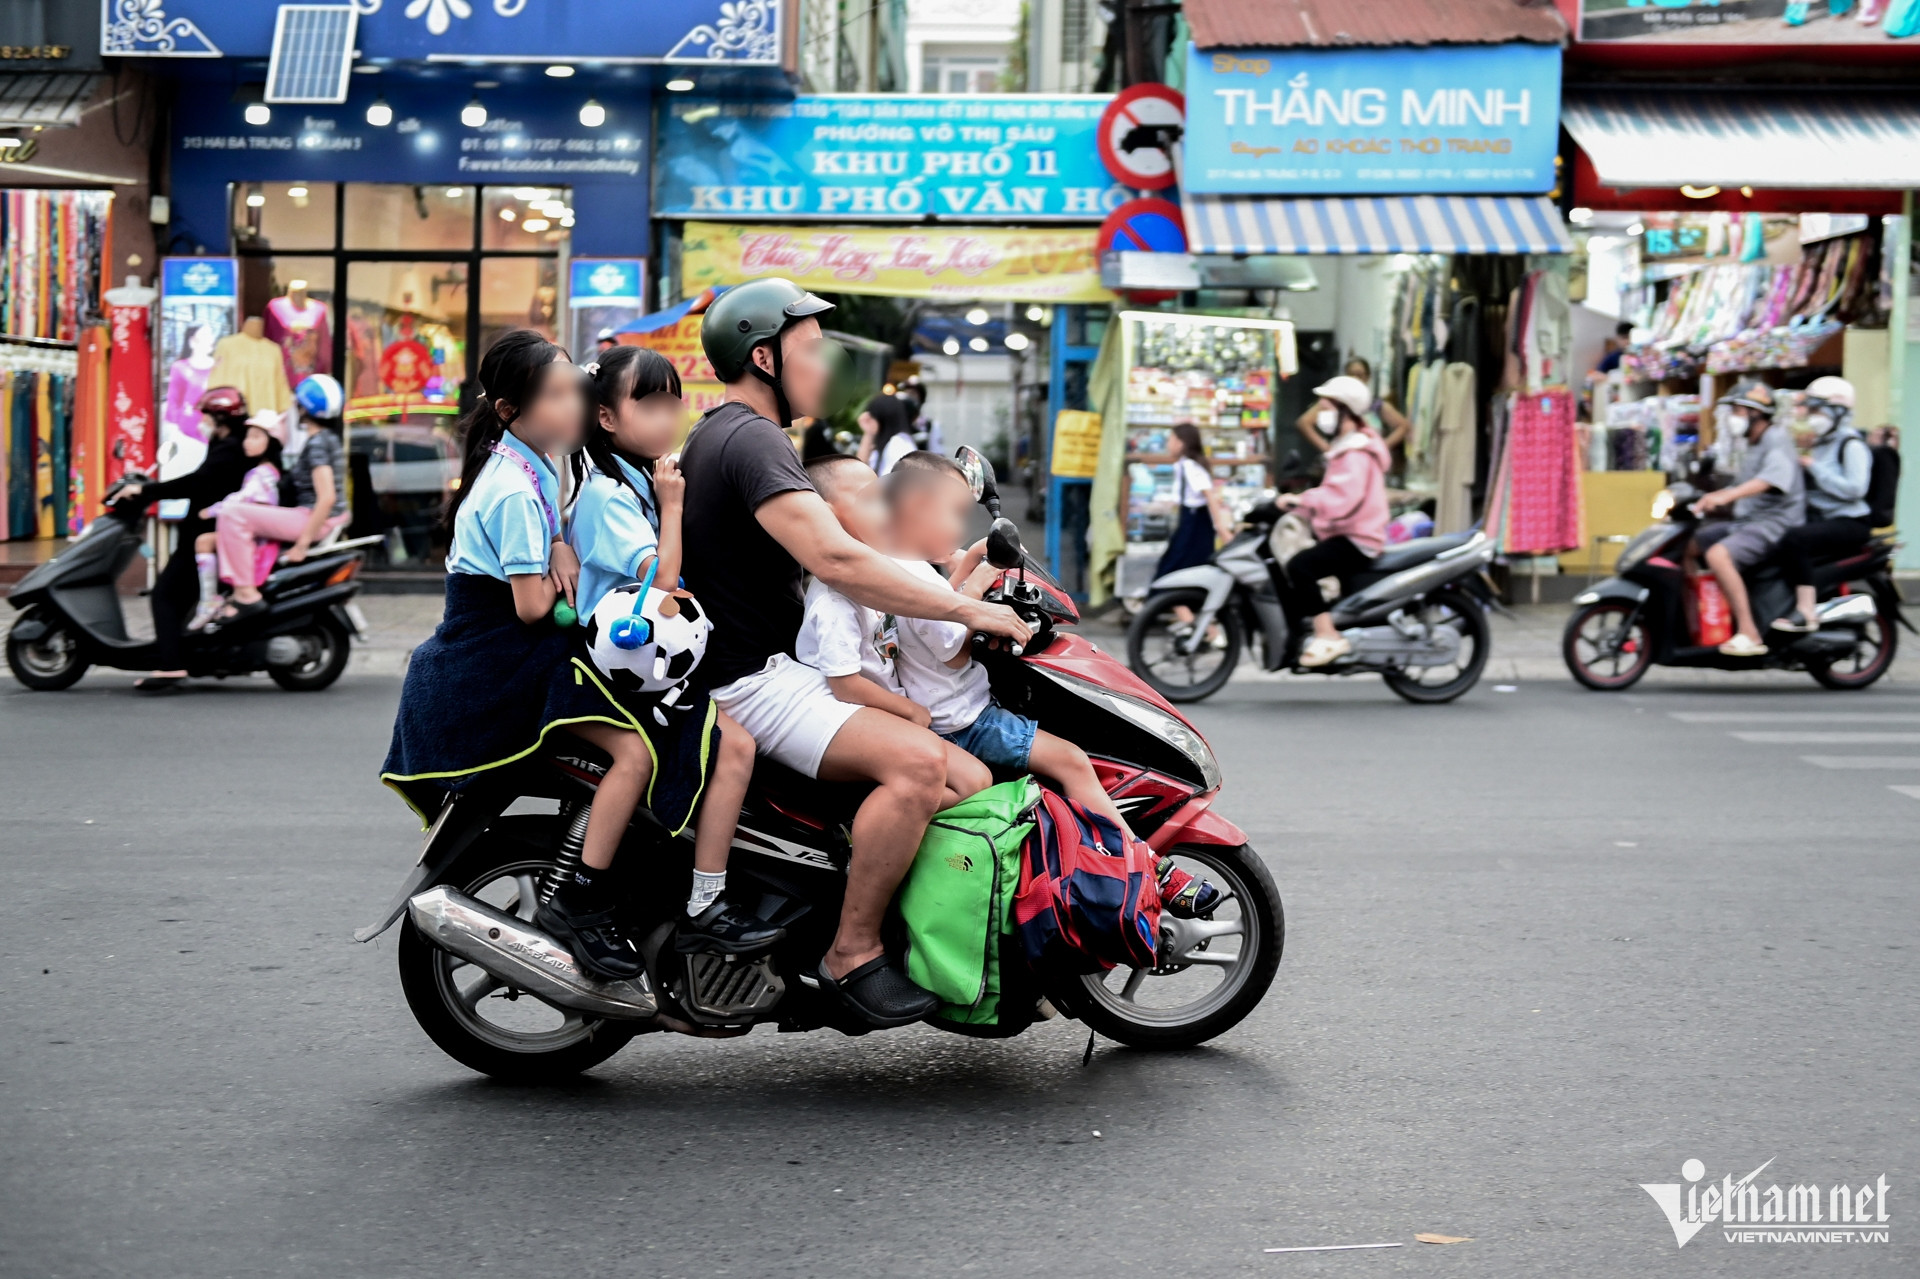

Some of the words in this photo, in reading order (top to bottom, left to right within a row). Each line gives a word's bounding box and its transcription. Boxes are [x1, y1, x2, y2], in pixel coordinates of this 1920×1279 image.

[1212, 54, 1271, 77] Shop
[1214, 71, 1387, 126] THẮNG
[1401, 88, 1530, 126] MINH
[920, 122, 954, 141] VÕ
[959, 126, 1002, 144] THỊ
[1005, 123, 1056, 141] SÁU
[1445, 138, 1513, 154] TRANG
[812, 151, 909, 174] KHU
[922, 142, 1015, 175] PHỐ
[1026, 150, 1058, 176] 11
[690, 186, 801, 211] KHU
[817, 175, 926, 211] PHỐ
[938, 180, 1047, 212] VĂN
[1004, 235, 1099, 275] 202
[556, 756, 608, 777] AIR
[531, 950, 573, 973] BLADE
